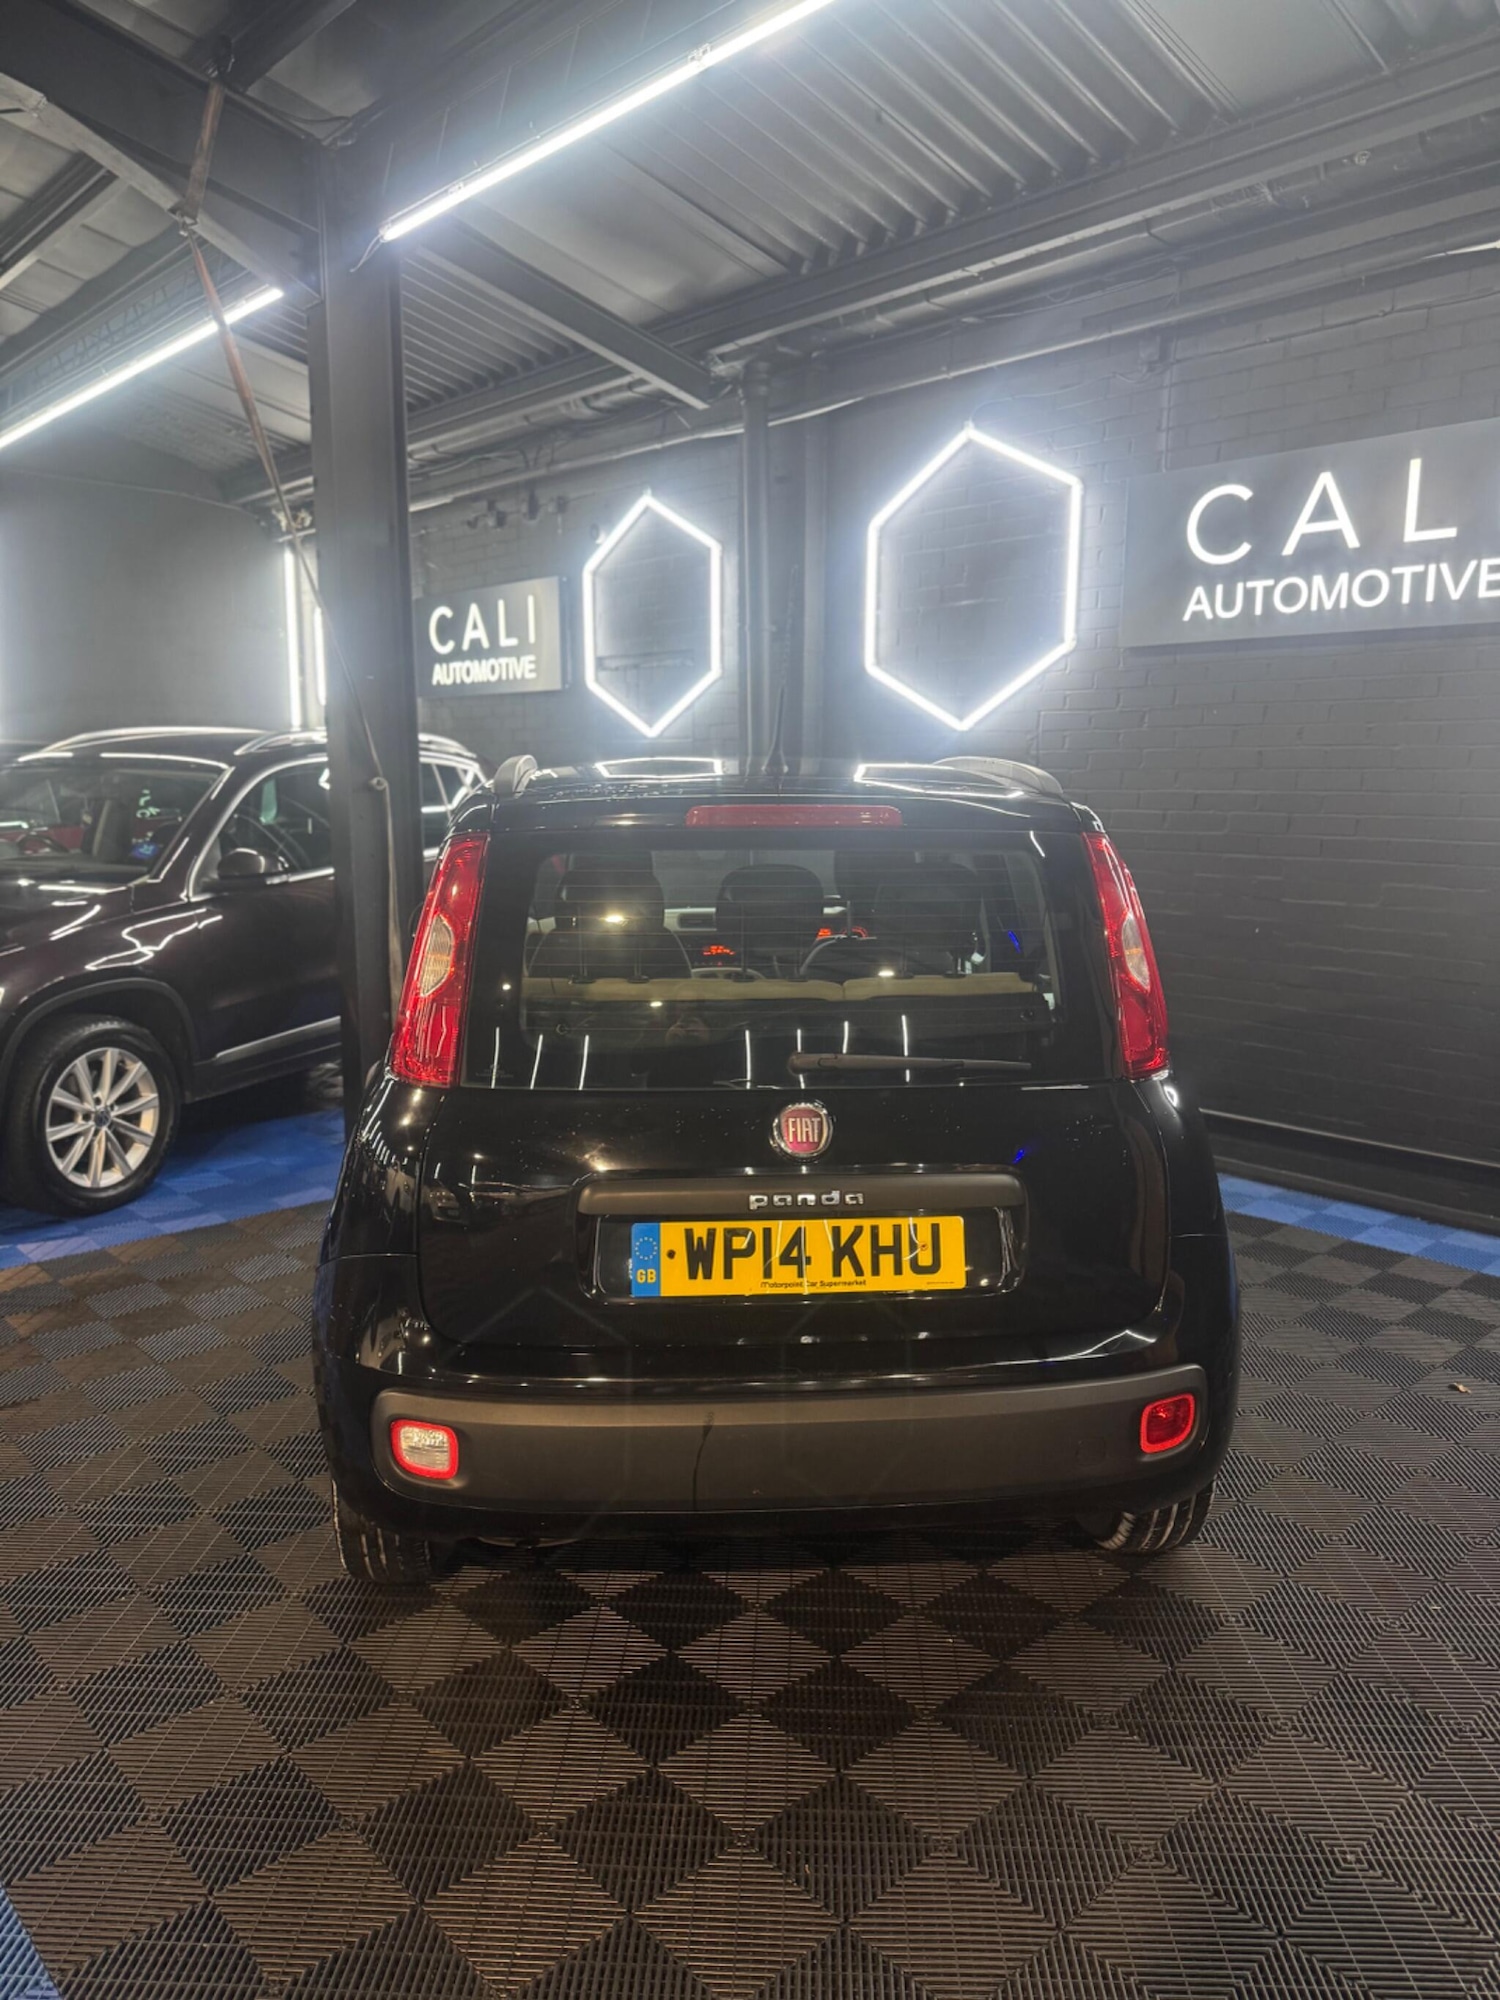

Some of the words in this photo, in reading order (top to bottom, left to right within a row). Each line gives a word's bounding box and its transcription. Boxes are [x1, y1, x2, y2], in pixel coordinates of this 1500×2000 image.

[1182, 557, 1500, 622] AUTOMOTIVE
[429, 594, 536, 655] CALI
[432, 655, 537, 686] AUTOMOTIVE
[787, 1117, 821, 1143] FIAT
[749, 1190, 864, 1210] panda
[684, 1226, 811, 1280] WP14
[832, 1222, 941, 1278] KHU
[636, 1268, 657, 1284] GB
